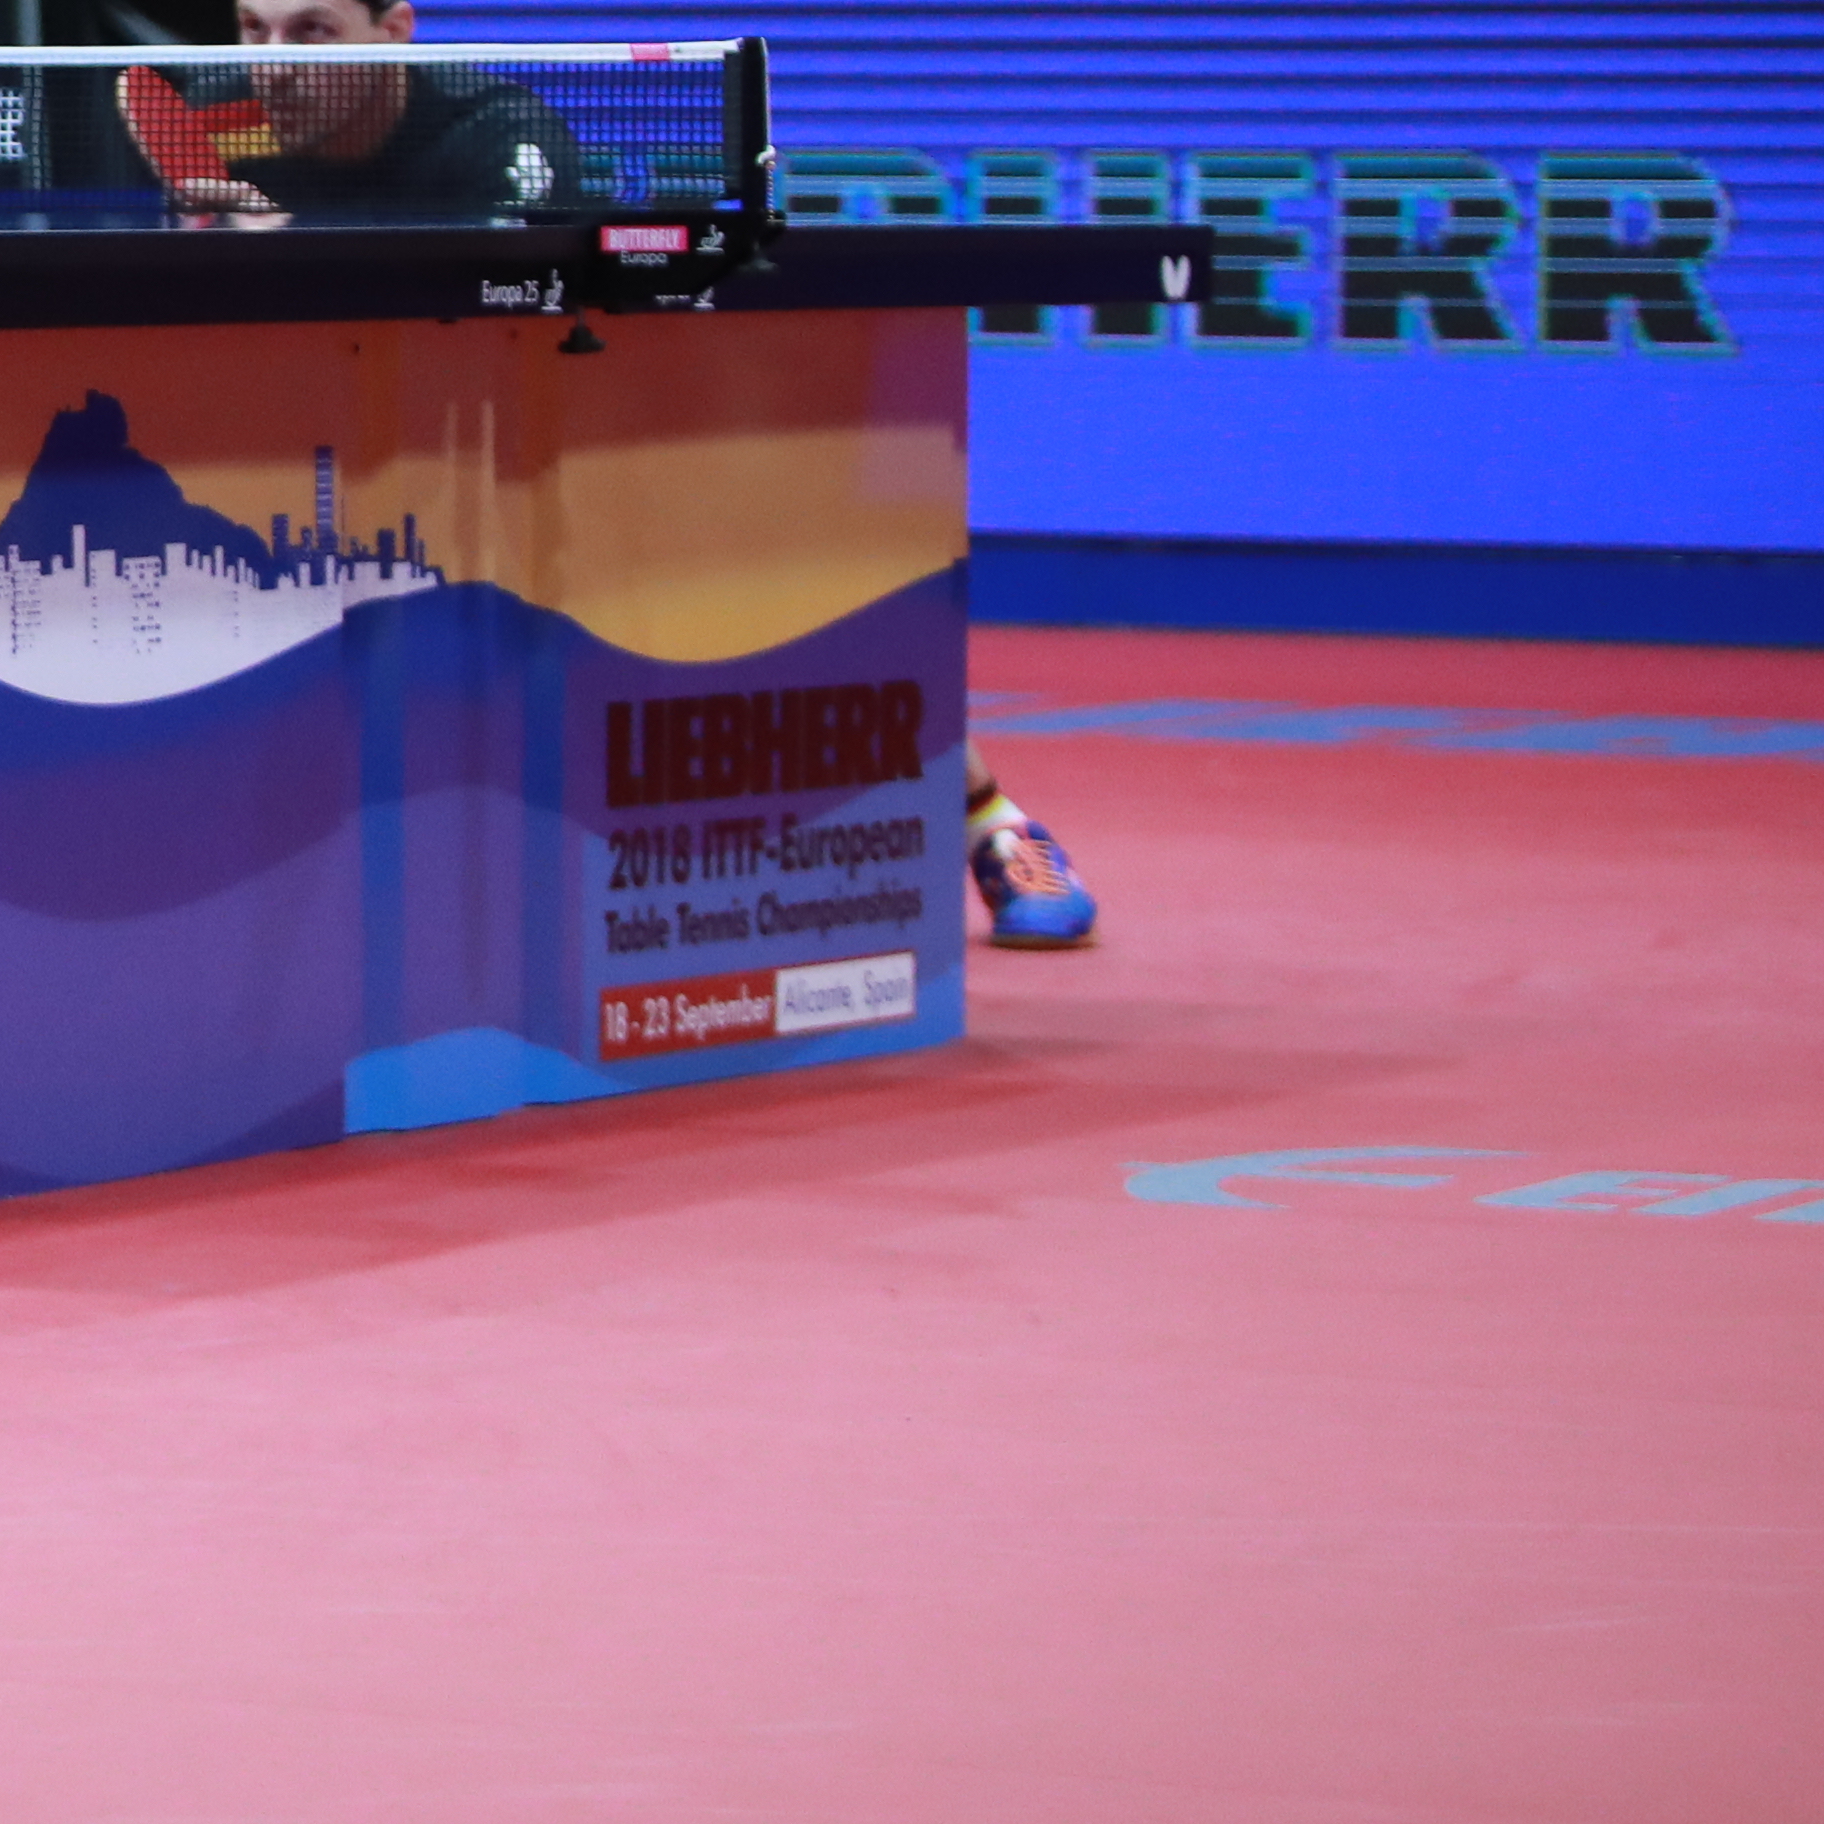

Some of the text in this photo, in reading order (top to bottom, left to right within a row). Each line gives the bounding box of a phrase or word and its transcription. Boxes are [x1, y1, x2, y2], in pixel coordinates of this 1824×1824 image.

[609, 227, 682, 249] BUTTERFLY
[620, 250, 668, 267] Europa
[481, 279, 540, 308] Europa 25
[606, 678, 925, 810] LIEBHERR
[608, 812, 926, 890] 2018 ITTF-European
[604, 878, 922, 954] Table Tennis Championships
[604, 1000, 629, 1043] 18
[642, 994, 671, 1039] 23
[674, 981, 774, 1041] September
[861, 968, 912, 1012] Spain
